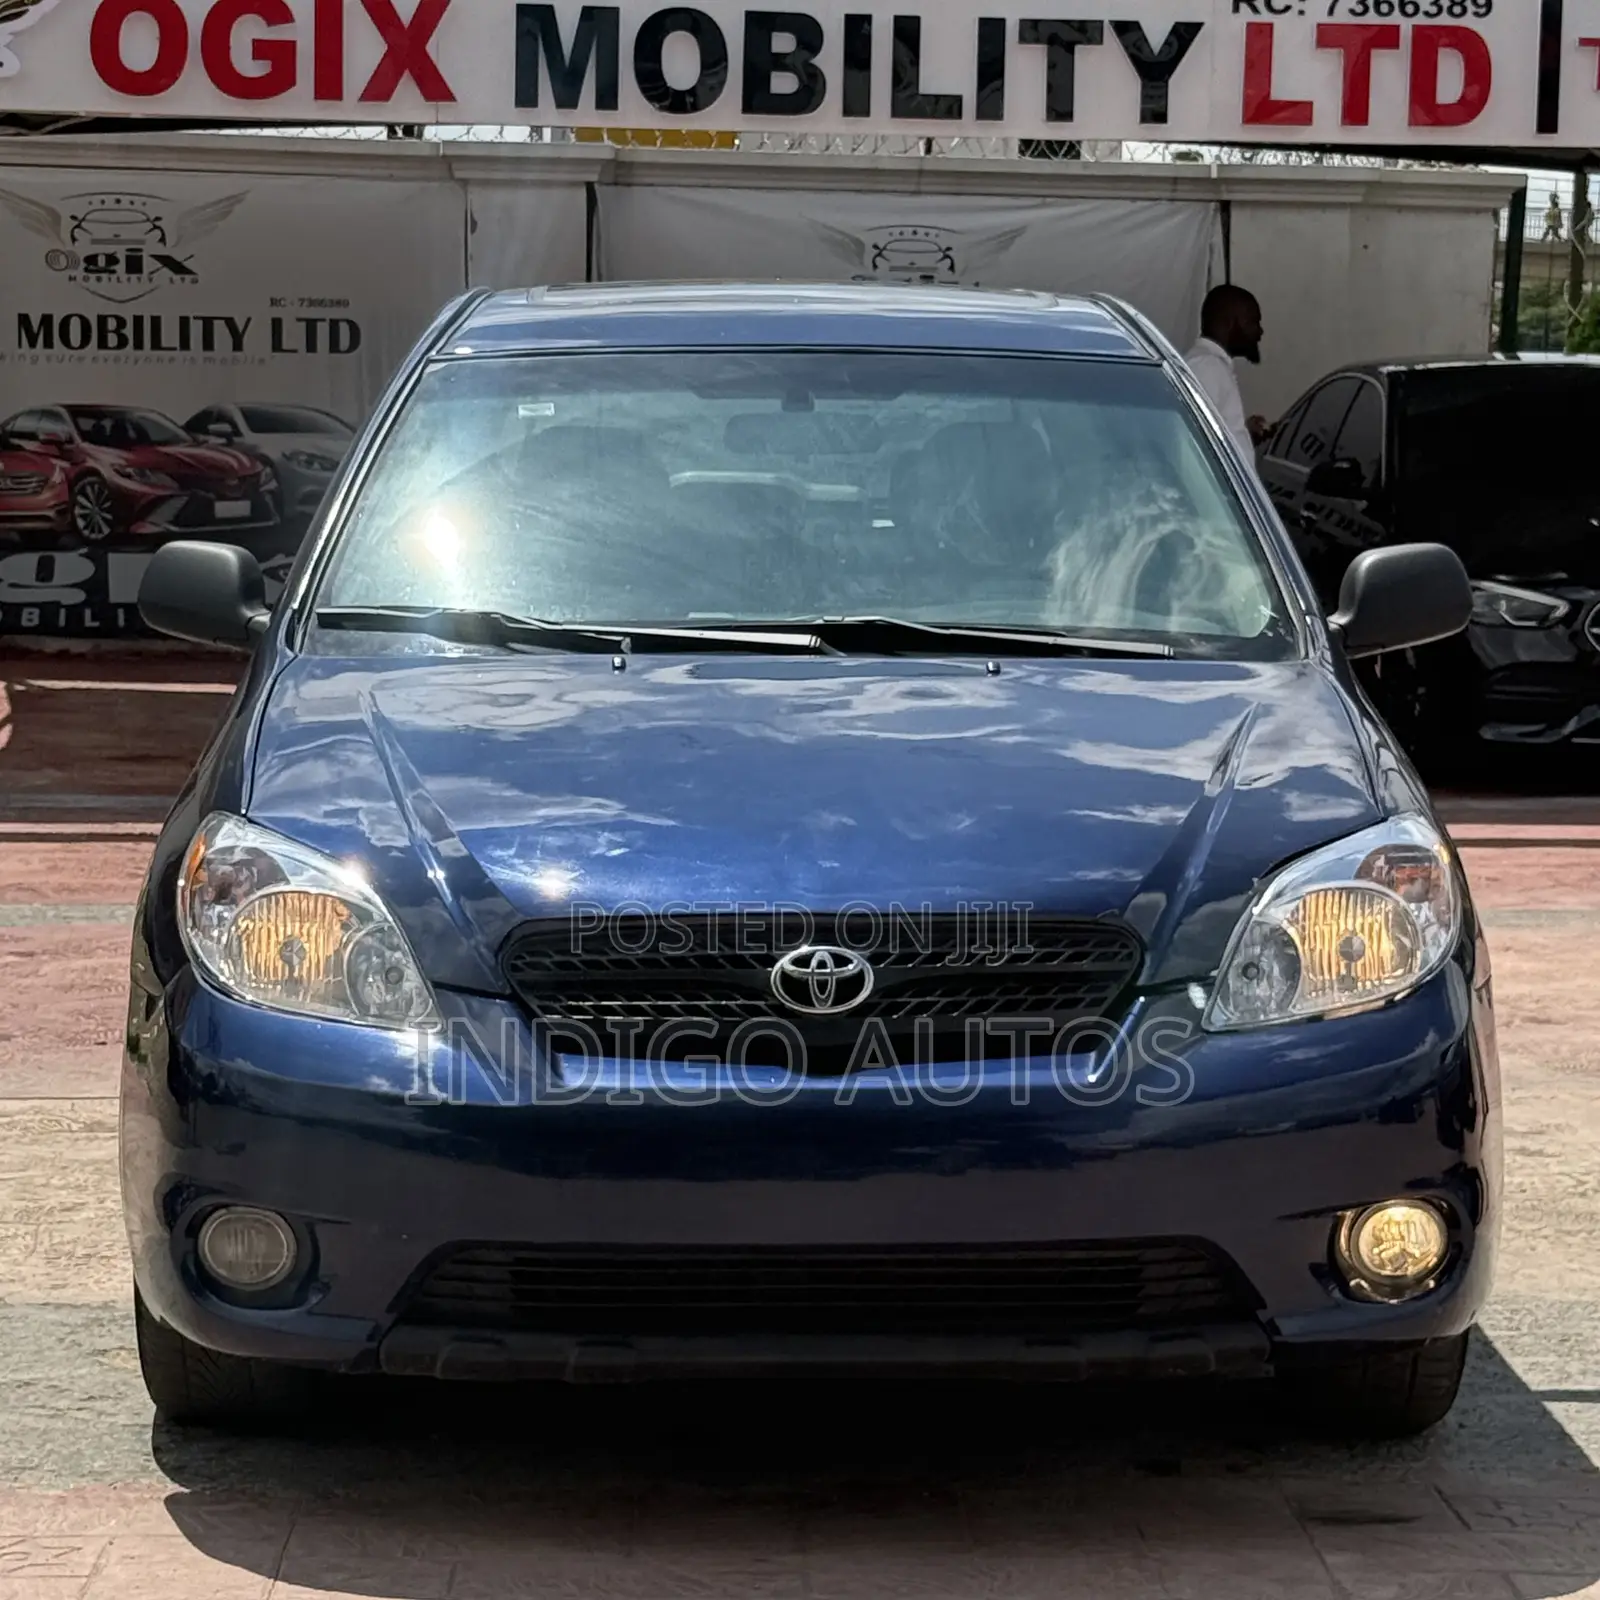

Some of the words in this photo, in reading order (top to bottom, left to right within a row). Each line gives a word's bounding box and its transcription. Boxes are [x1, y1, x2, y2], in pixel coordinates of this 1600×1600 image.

[1326, 0, 1493, 18] 7366389
[90, 0, 457, 102] OGIX
[514, 3, 1205, 126] MOBILITY
[1241, 22, 1492, 127] LTD
[17, 313, 252, 351] MOBILITY
[270, 316, 362, 354] LTD
